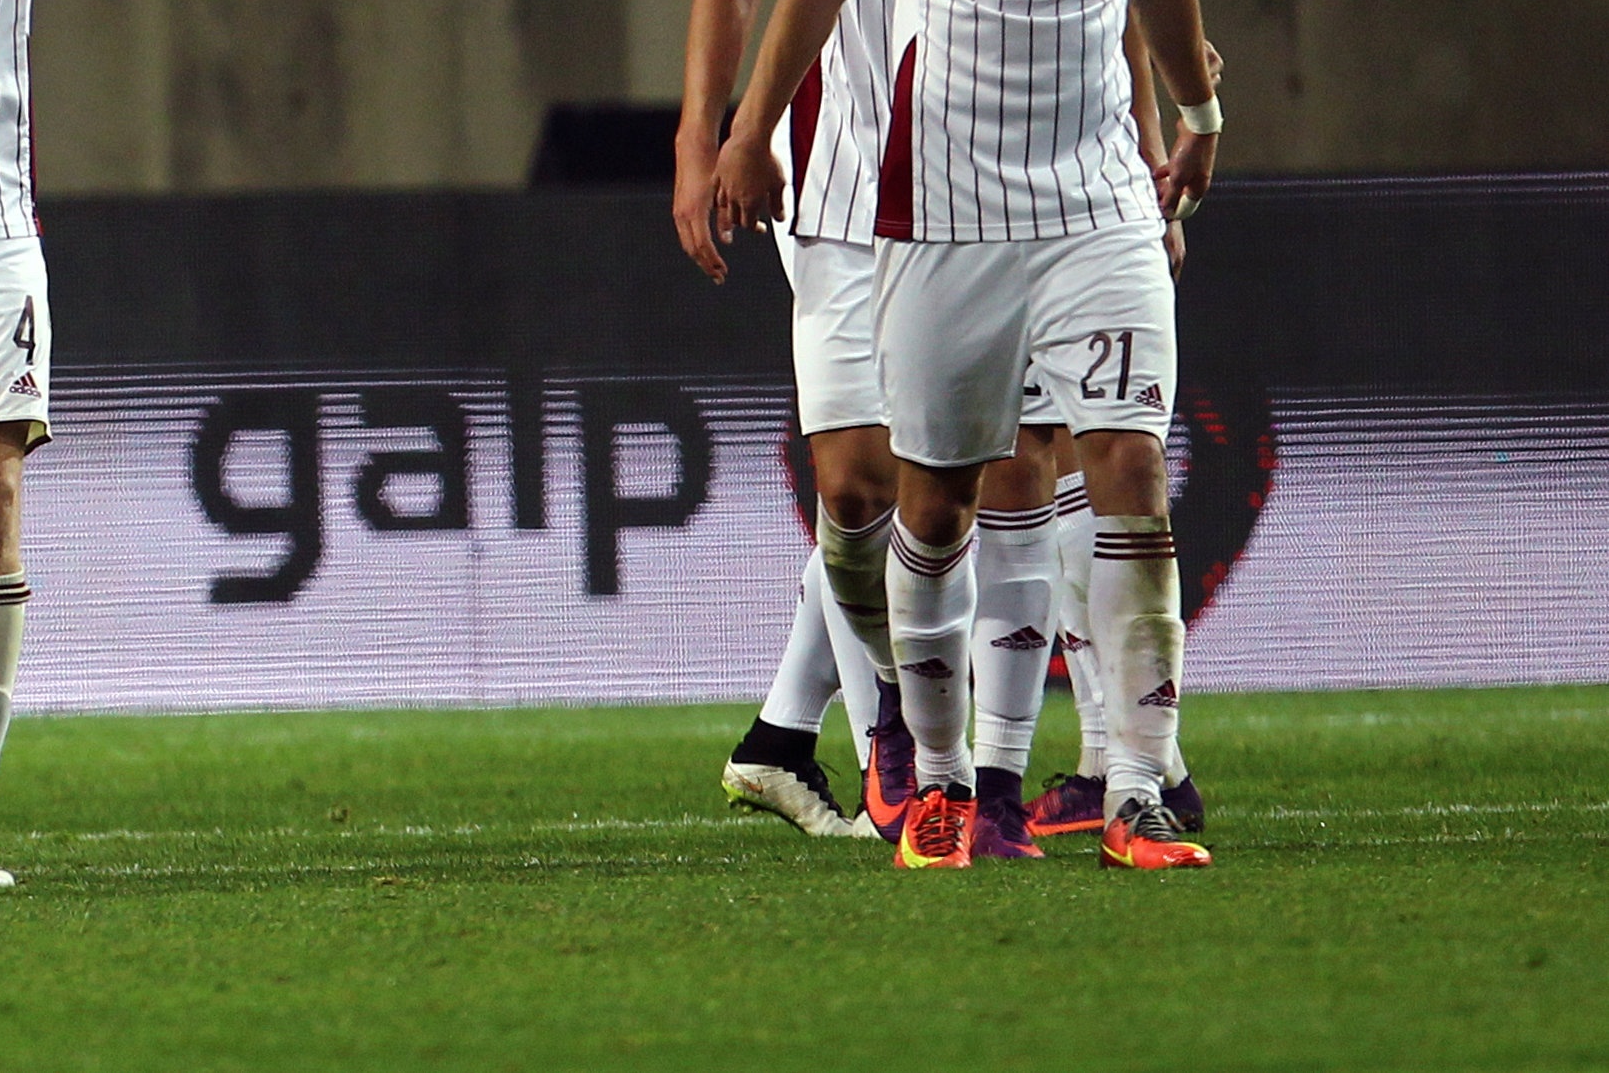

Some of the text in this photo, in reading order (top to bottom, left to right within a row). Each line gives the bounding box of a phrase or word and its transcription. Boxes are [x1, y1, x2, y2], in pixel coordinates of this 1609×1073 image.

[12, 294, 36, 366] 4
[1081, 330, 1134, 401] 21
[193, 367, 712, 604] galp
